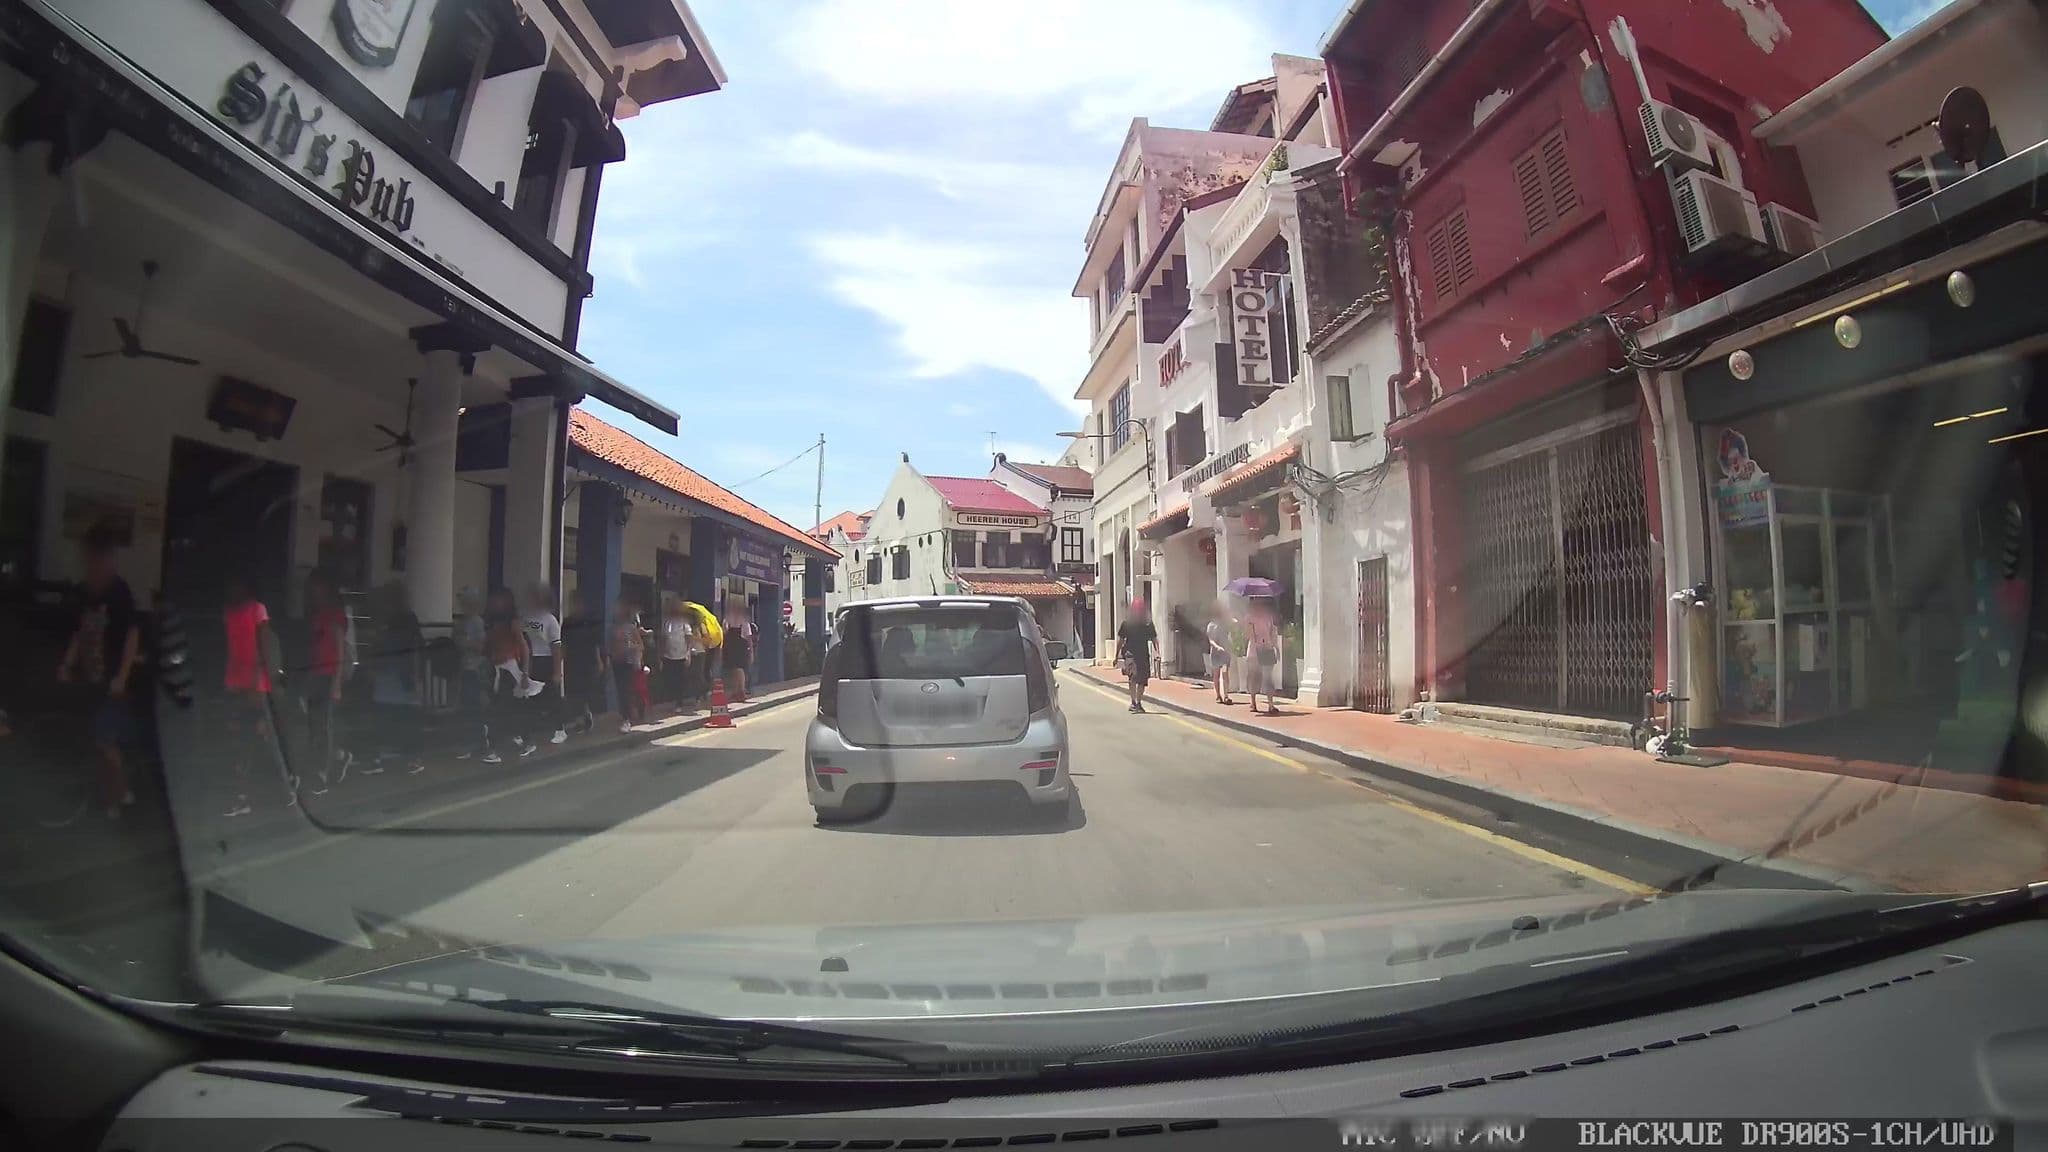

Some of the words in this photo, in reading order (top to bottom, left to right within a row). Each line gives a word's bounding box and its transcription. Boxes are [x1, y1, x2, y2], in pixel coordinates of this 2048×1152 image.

[217, 61, 336, 177] Sid's
[332, 139, 415, 232] Pub
[1231, 268, 1271, 385] HOTEL
[966, 515, 999, 524] HEEREN
[1002, 517, 1030, 526] HOUSE
